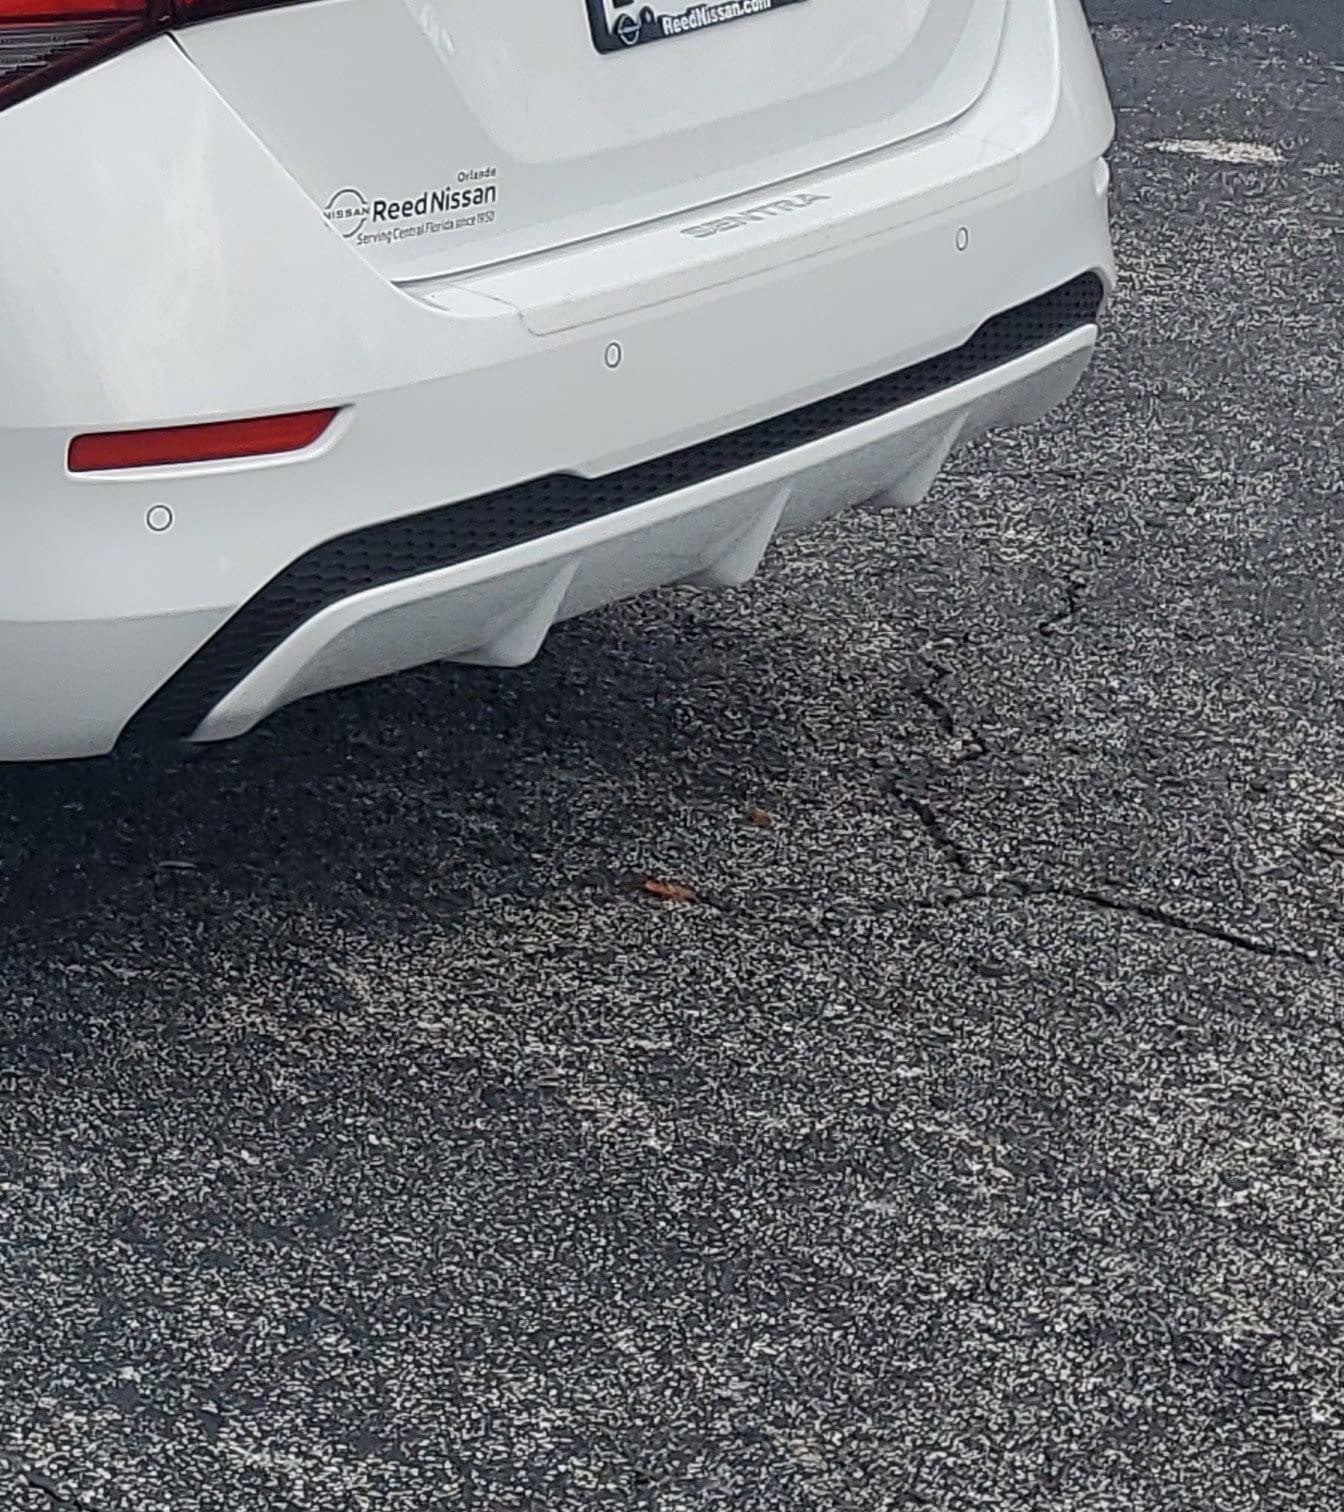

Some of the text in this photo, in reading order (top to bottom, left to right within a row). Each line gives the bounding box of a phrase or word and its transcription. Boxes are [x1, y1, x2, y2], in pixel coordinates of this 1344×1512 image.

[457, 167, 497, 184] Orlando
[372, 184, 497, 223] Reed Nissan
[323, 205, 370, 221] NISSAN
[680, 192, 833, 238] SENTRA
[356, 228, 392, 246] Serving
